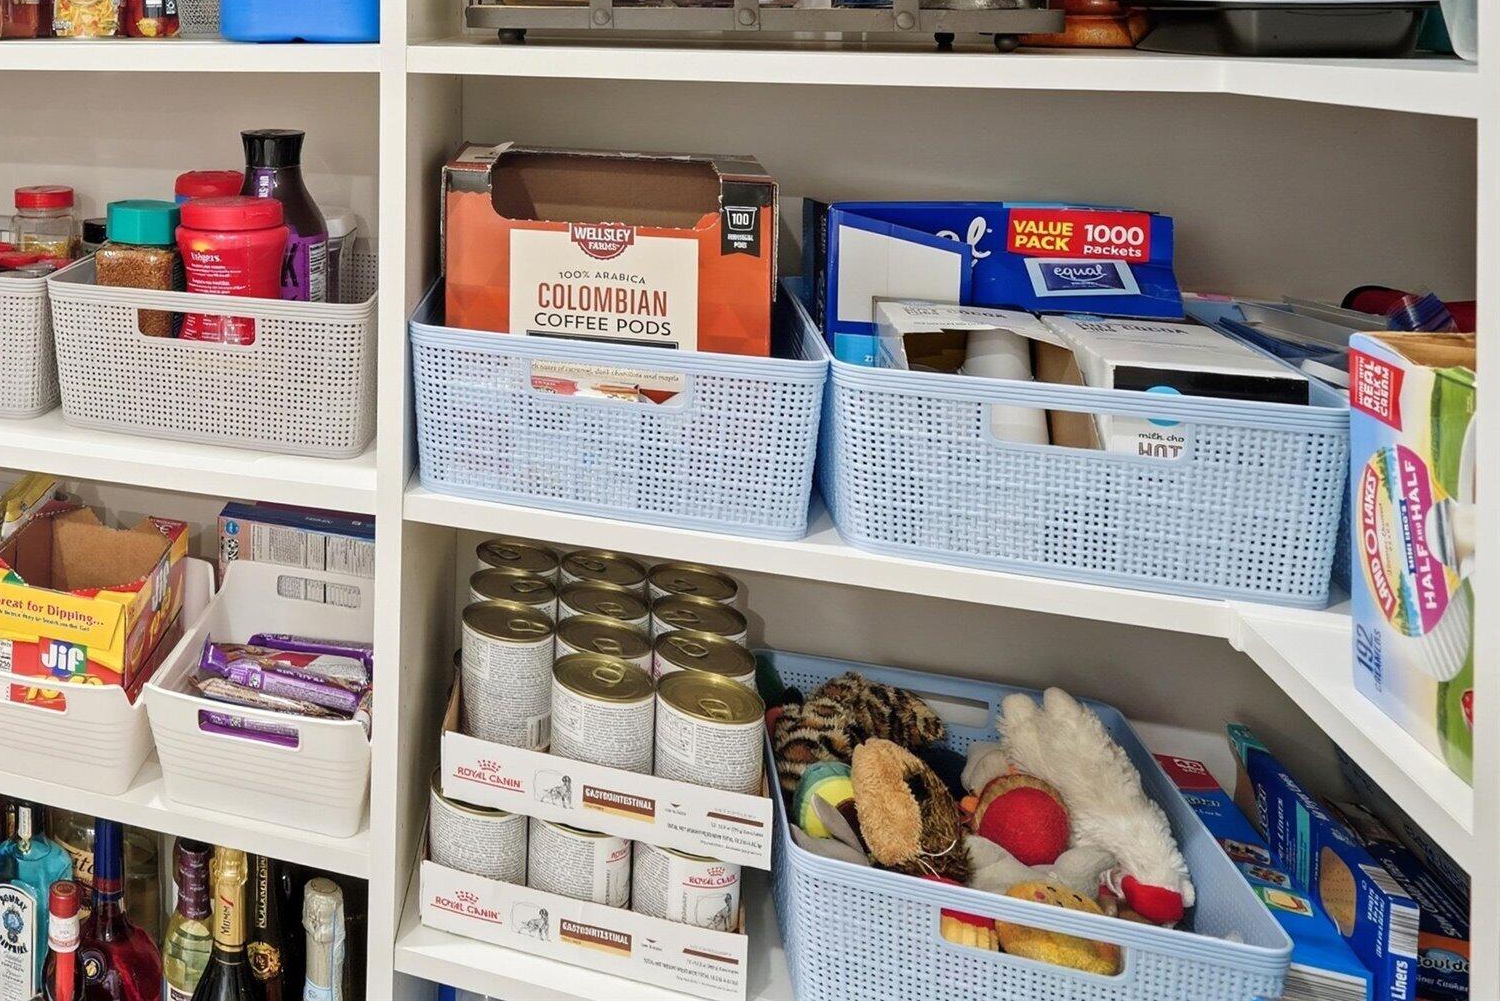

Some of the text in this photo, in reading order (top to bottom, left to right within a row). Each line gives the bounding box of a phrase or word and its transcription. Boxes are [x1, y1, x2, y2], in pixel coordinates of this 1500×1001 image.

[731, 212, 749, 226] 100
[1013, 219, 1074, 236] VALUE
[574, 225, 632, 243] WELLSLEY
[588, 240, 620, 251] FARMS
[1015, 235, 1070, 251] PACK
[1084, 224, 1144, 246] 1000
[1083, 245, 1142, 258] packets
[559, 270, 647, 285] 100% ARABICA
[1053, 263, 1107, 281] equal
[537, 282, 668, 318] COLOMBIAN
[534, 311, 672, 337] COFFEE PODS
[1363, 360, 1375, 410] REAL
[1372, 376, 1383, 414] MILK
[1380, 366, 1390, 418] CREAM
[1138, 431, 1185, 443] milk cho
[1404, 459, 1424, 522] HALF
[1364, 469, 1392, 611] LAND O LAKES
[1416, 544, 1437, 610] HALF
[27, 600, 44, 613] for
[47, 604, 104, 627] Dipping...
[41, 643, 85, 672] Jif
[1356, 623, 1374, 673] 192
[457, 765, 521, 790] ROYAL CANIN
[0, 894, 28, 911] BOMBAY
[435, 896, 499, 921] ROYAL CANIN
